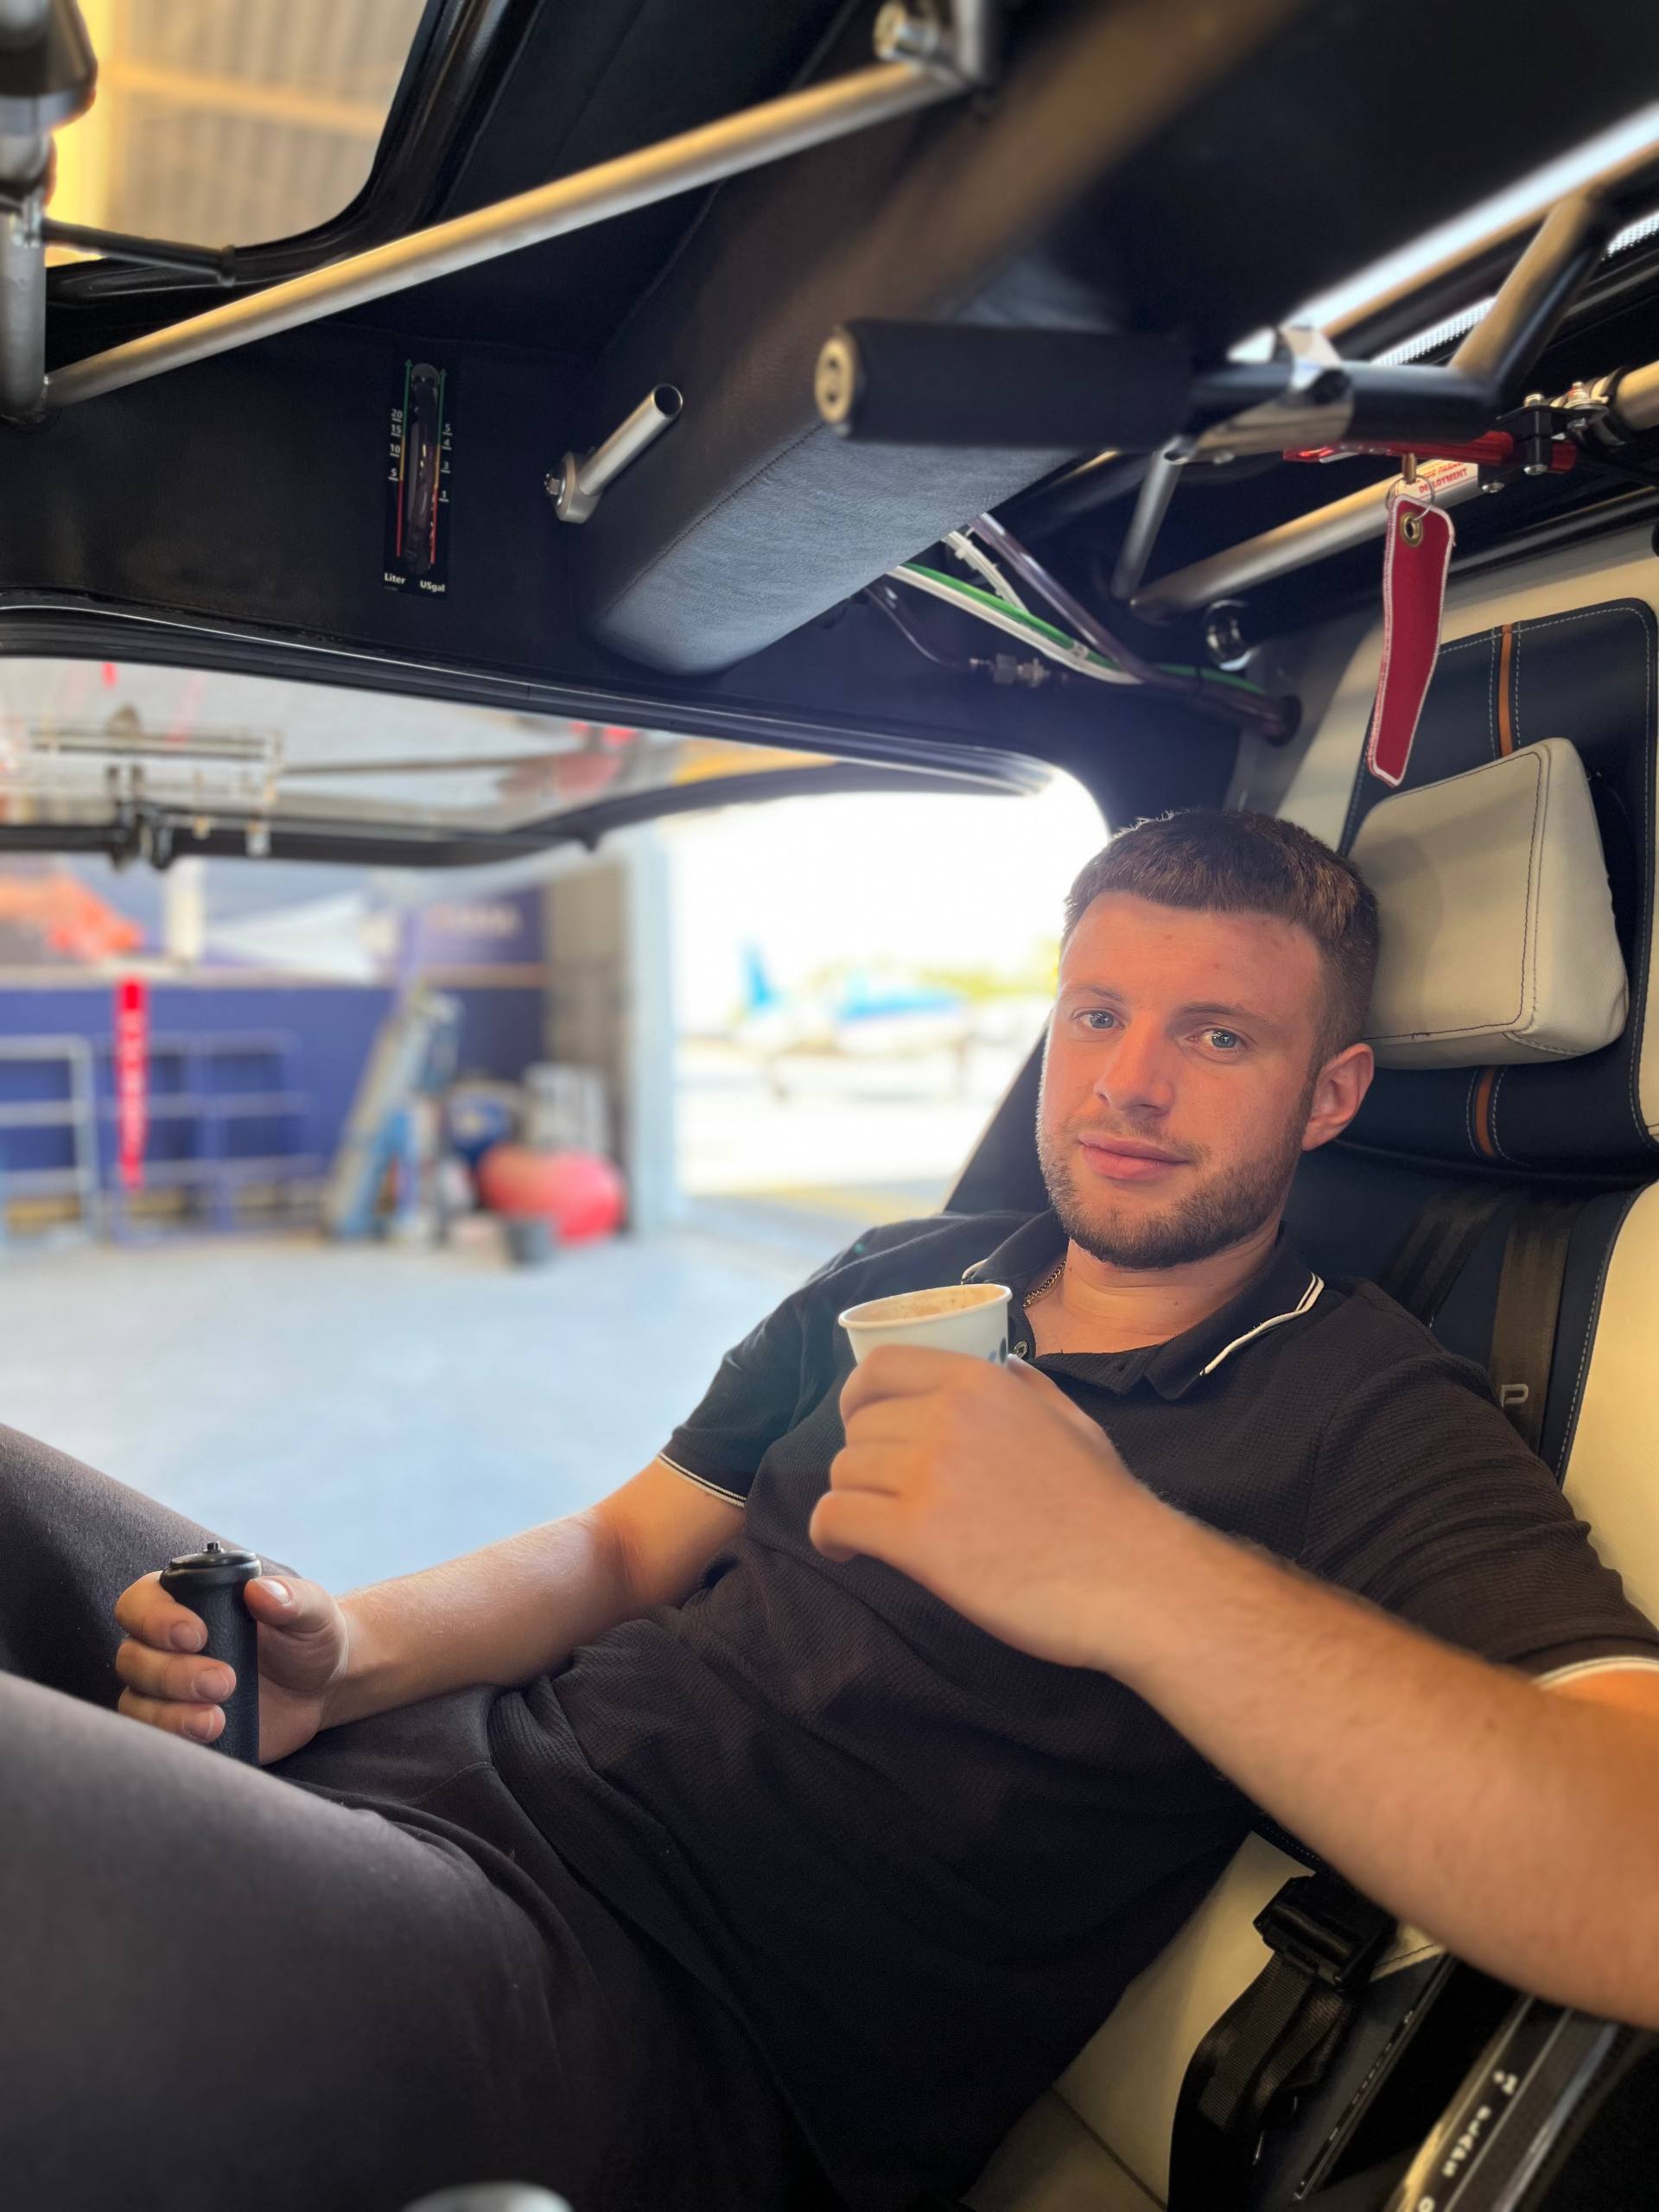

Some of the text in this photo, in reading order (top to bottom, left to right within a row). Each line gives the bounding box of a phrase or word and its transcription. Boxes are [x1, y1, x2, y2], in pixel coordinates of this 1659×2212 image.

[391, 409, 403, 418] 20
[391, 424, 402, 433] 15
[444, 423, 450, 433] 5
[390, 444, 401, 454] 10
[384, 572, 406, 584] Liter
[420, 580, 445, 593] USgal
